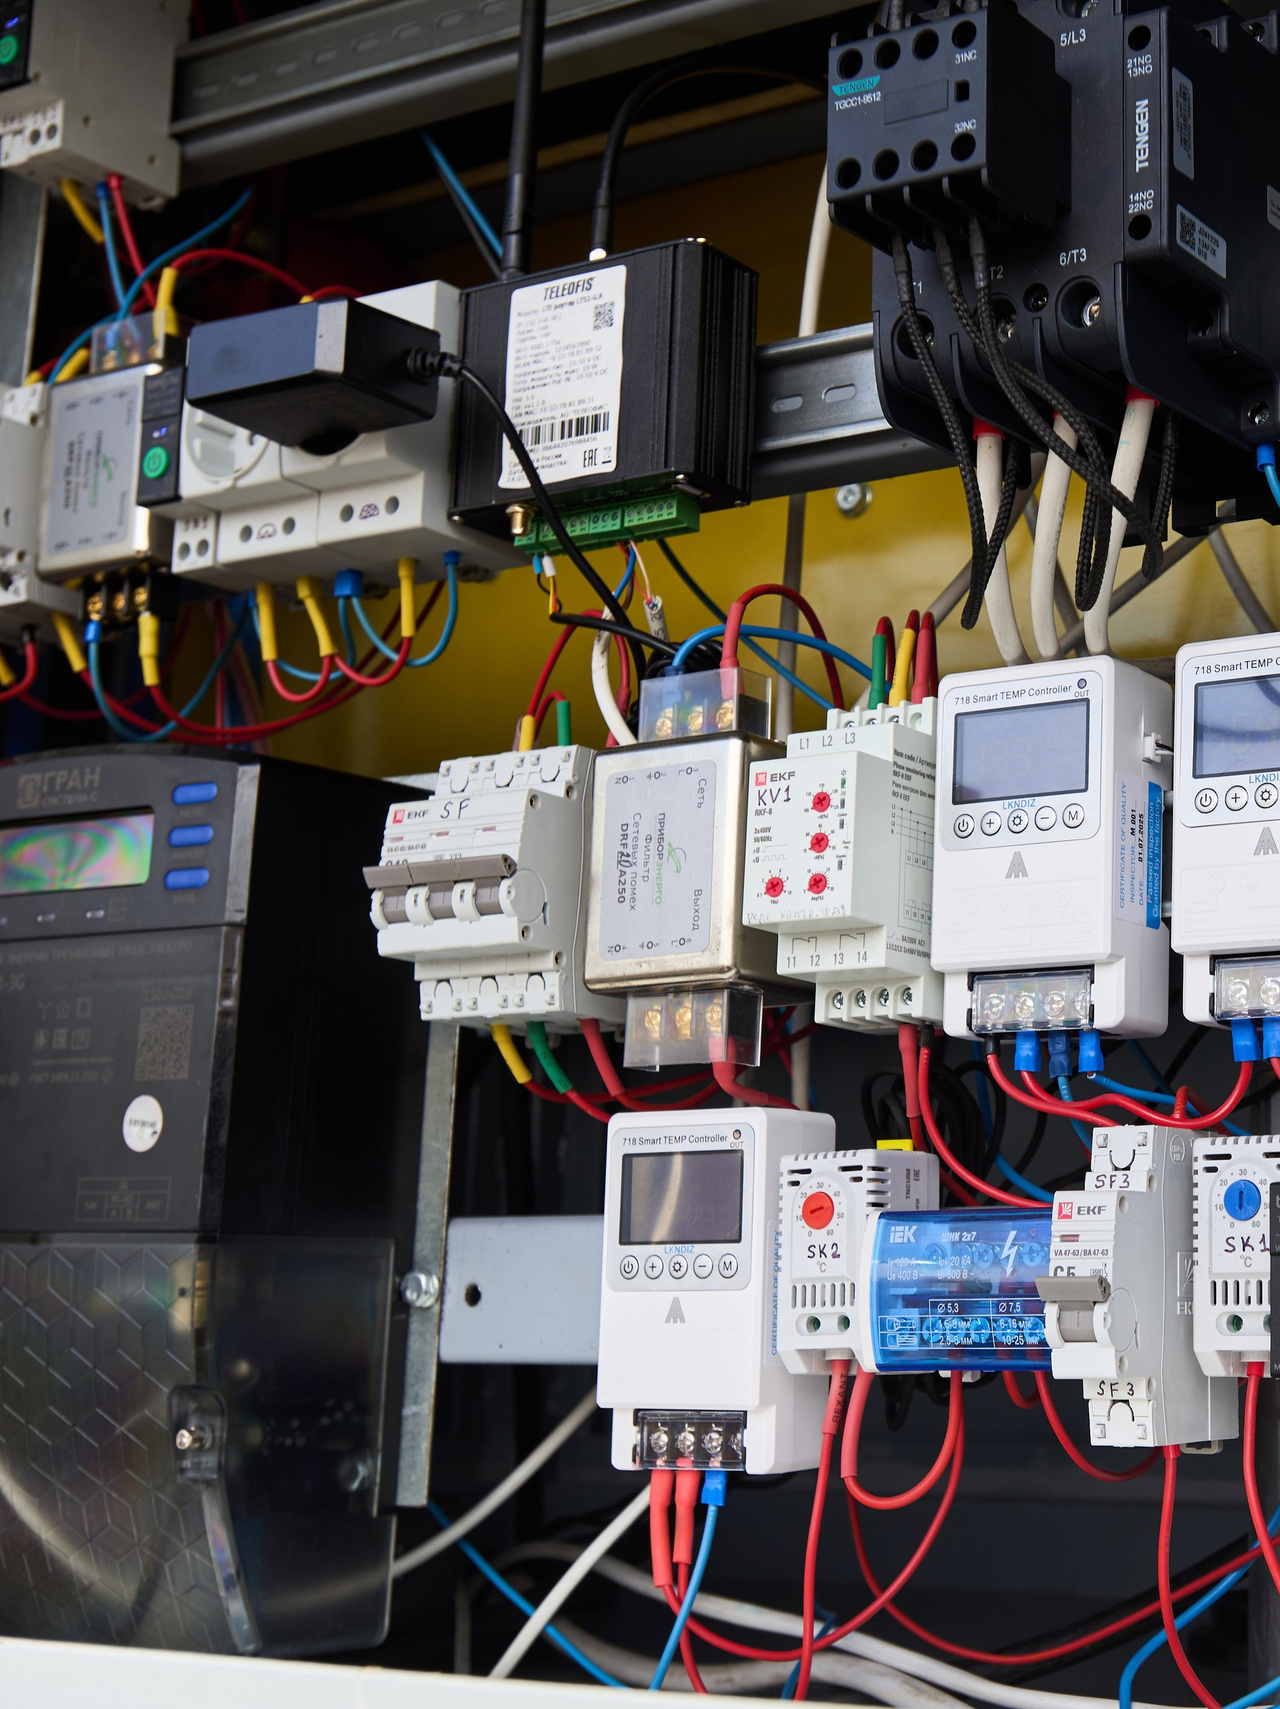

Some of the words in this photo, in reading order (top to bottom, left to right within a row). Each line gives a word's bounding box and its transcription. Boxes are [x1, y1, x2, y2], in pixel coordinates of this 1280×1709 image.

[1060, 28, 1087, 47] 5/L3
[954, 50, 977, 64] 31NC
[1127, 54, 1152, 68] 21NC
[1127, 65, 1153, 78] 13NO
[954, 119, 977, 133] 32NC
[1135, 99, 1150, 172] TENGEN
[1128, 189, 1155, 203] 14NO
[1128, 200, 1154, 213] 22NC
[1059, 248, 1087, 266] 6/T3
[543, 276, 598, 301] TELEOFIS
[1194, 665, 1213, 676] 718
[1214, 661, 1243, 674] Smart
[1244, 656, 1274, 670] TEMP
[954, 695, 971, 706] 718
[972, 692, 999, 704] Smart
[1000, 688, 1027, 701] TEMP
[1028, 683, 1073, 698] Controller
[1074, 690, 1090, 698] OUT
[799, 738, 810, 750] L1
[822, 735, 833, 747] L2
[844, 732, 856, 745] L3
[44, 767, 100, 792] ГРАН
[770, 771, 796, 782] EKF
[697, 778, 707, 809] Сеть
[757, 785, 792, 807] KV1
[1002, 798, 1036, 810] LKNDIZ
[1120, 782, 1128, 825] QUALITY
[407, 809, 429, 820] EKF
[754, 808, 773, 817] RKF-8
[631, 812, 642, 868] Сетевых
[640, 833, 653, 883] Фильтр
[629, 871, 638, 911] помех
[691, 888, 703, 931] Выход
[786, 956, 797, 969] 11
[810, 954, 821, 967] 12
[833, 952, 844, 965] 13
[857, 950, 868, 963] 14
[622, 1136, 638, 1147] 718
[638, 1135, 663, 1146] Smart
[662, 1134, 688, 1146] TEMP
[687, 1132, 729, 1145] Controller
[729, 1141, 744, 1149] OUT
[1238, 1168, 1247, 1177] 30
[816, 1181, 824, 1190] 30
[1095, 1173, 1131, 1190] SF3
[1219, 1178, 1228, 1187] 20
[1258, 1178, 1267, 1186] 40
[800, 1191, 808, 1199] 20
[833, 1189, 841, 1198] 40
[1077, 1205, 1107, 1216] EKF
[1214, 1203, 1223, 1212] 10
[795, 1214, 803, 1222] 10
[836, 1211, 845, 1219] 50
[1252, 1220, 1261, 1229] 60
[826, 1229, 834, 1237] 60
[941, 1232, 961, 1242] ШНК
[664, 1244, 695, 1254] LKNDIZ
[1224, 1234, 1271, 1253] SK1
[807, 1242, 841, 1260] SK2
[950, 1256, 960, 1266] 20
[897, 1270, 911, 1280] 400
[947, 1302, 960, 1313] 5,3
[1008, 1301, 1022, 1313] 7,5
[771, 1294, 779, 1356] CERTIFICATE
[1002, 1335, 1025, 1346] 10-25
[1096, 1381, 1135, 1398] SF3
[831, 1372, 848, 1424] REXANT
